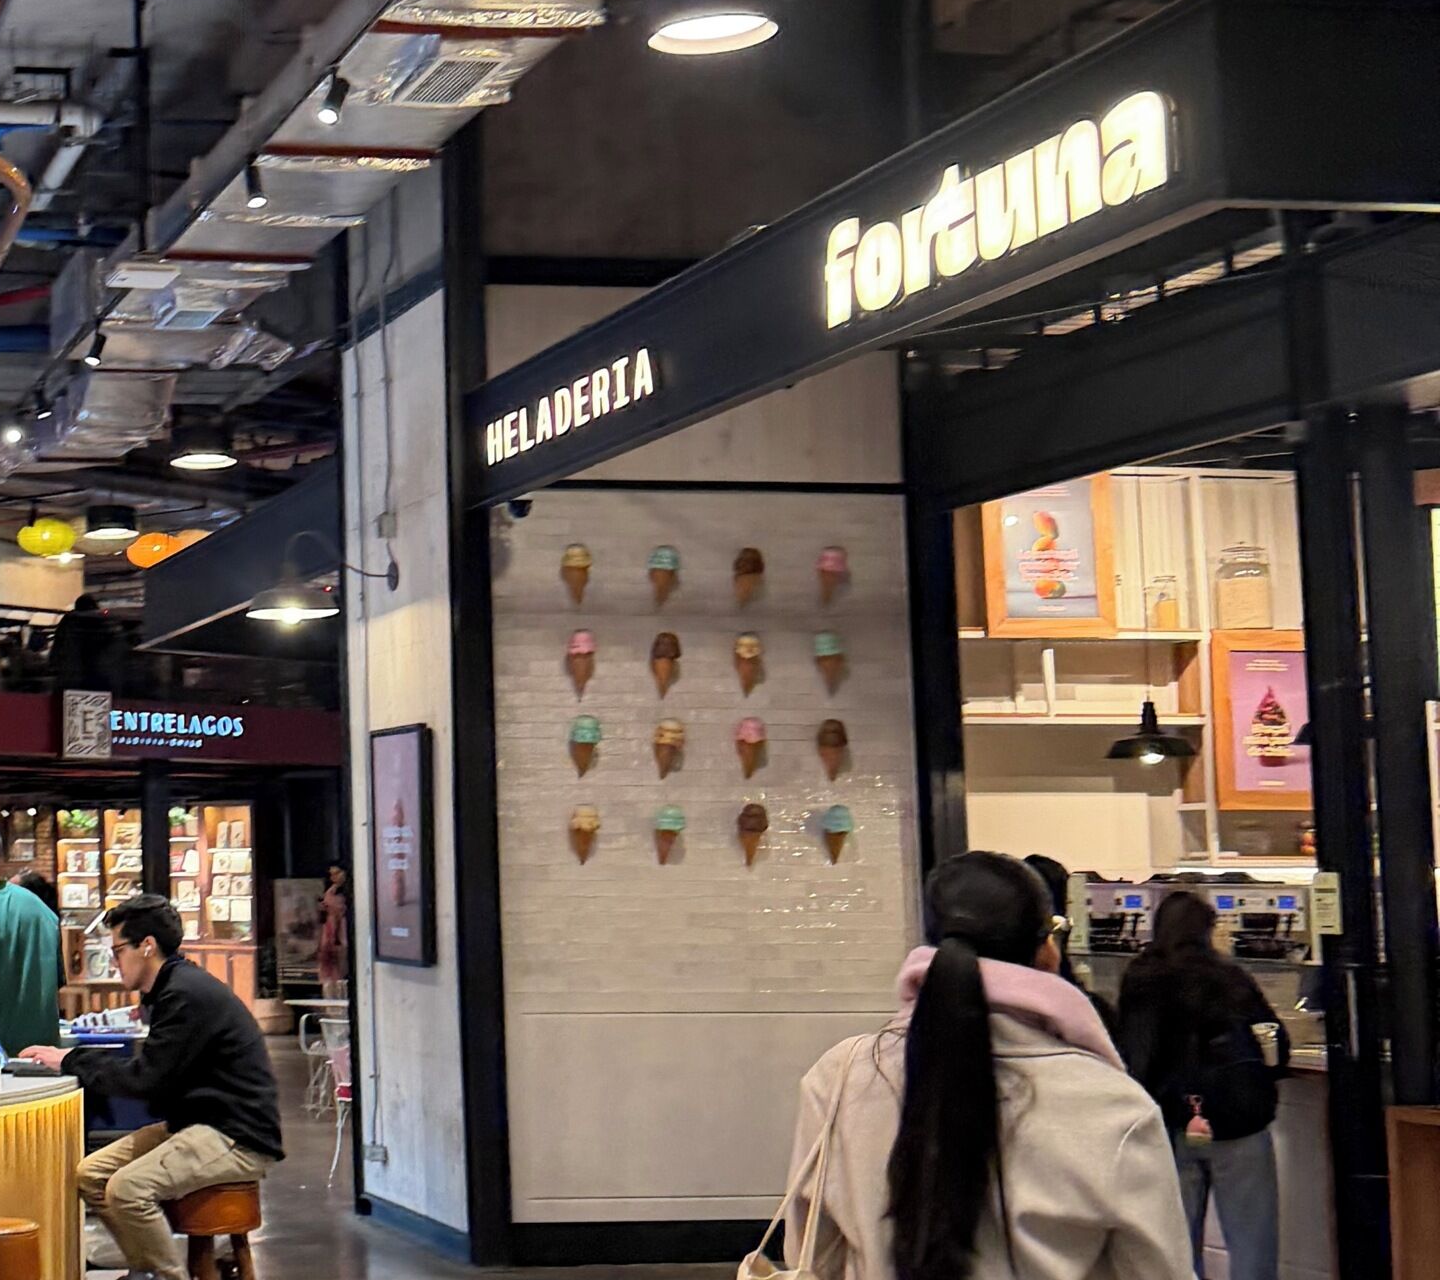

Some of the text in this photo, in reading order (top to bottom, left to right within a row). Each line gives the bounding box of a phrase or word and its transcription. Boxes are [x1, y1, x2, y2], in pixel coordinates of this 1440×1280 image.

[824, 90, 1167, 330] fortuna
[486, 347, 654, 466] HELADERIA
[109, 710, 244, 737] ENTRELAGOS
